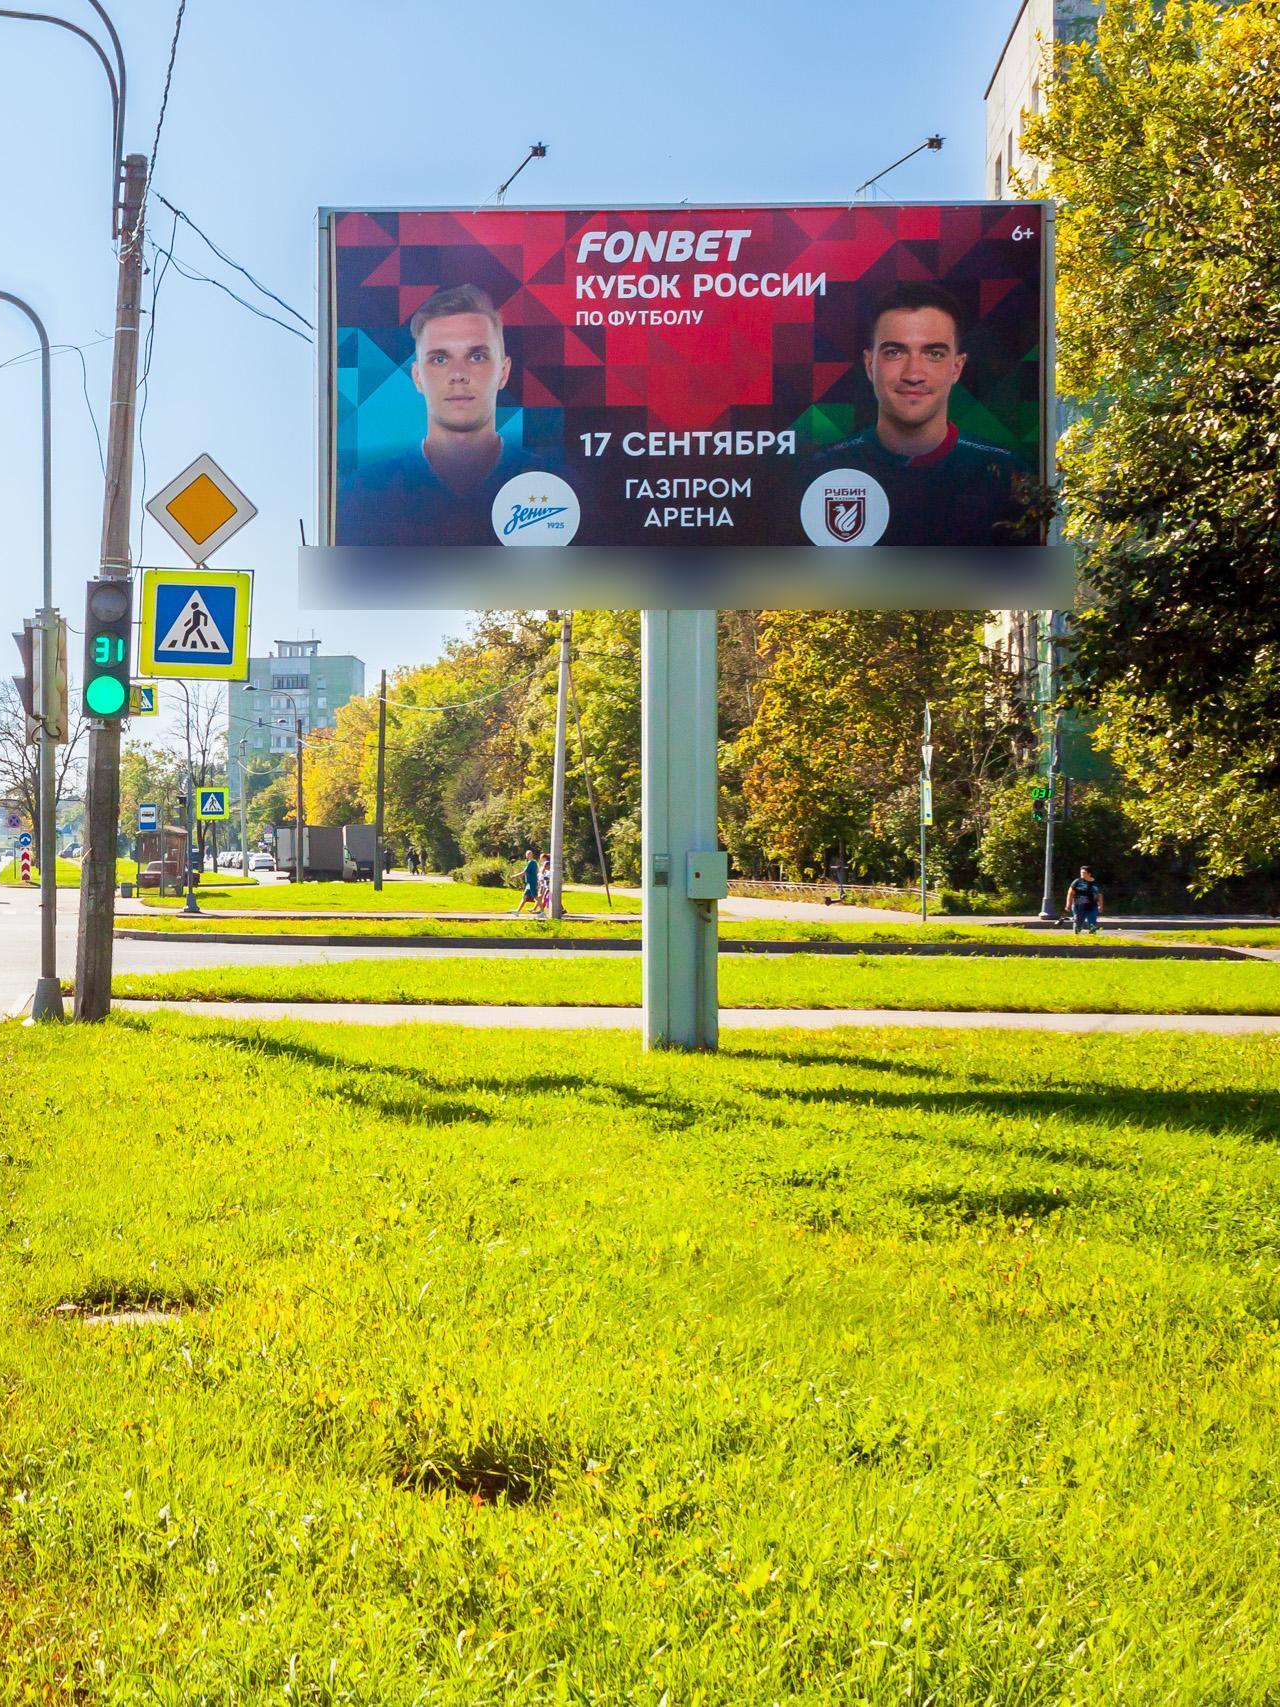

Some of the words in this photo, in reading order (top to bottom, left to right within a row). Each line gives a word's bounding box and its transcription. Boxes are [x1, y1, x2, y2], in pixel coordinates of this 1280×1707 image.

[1011, 225, 1035, 241] 6+
[576, 229, 752, 263] FONBET
[576, 274, 681, 299] КУБОК
[693, 272, 826, 298] РОССИИ
[576, 310, 603, 326] ПО
[607, 309, 704, 326] ФУТБОЛУ
[579, 432, 613, 457] 17
[622, 430, 796, 456] СЕНТЯБРЯ
[625, 477, 752, 499] ГАЗПРОМ
[824, 488, 866, 496] РУБИН
[643, 506, 735, 528] АРЕНА
[95, 636, 124, 663] 31
[1032, 788, 1052, 799] 031
